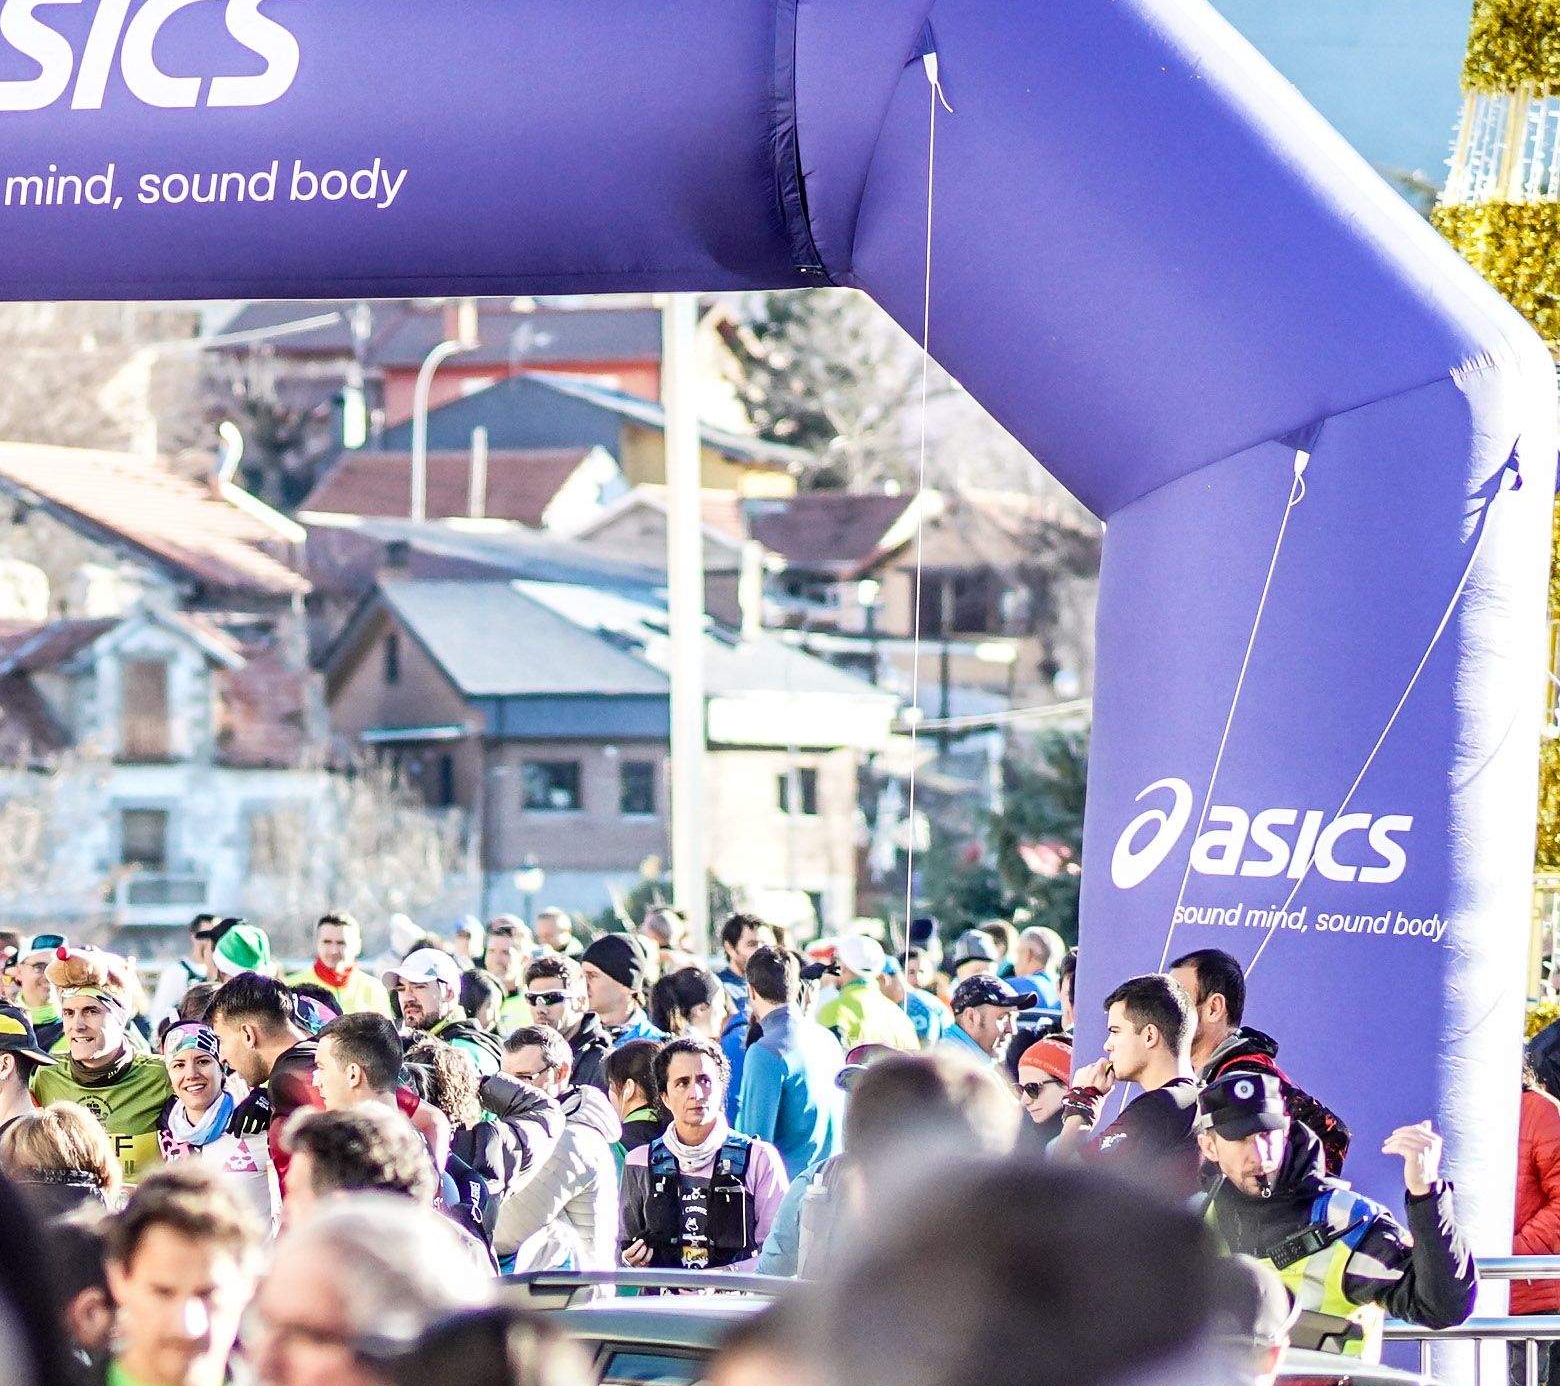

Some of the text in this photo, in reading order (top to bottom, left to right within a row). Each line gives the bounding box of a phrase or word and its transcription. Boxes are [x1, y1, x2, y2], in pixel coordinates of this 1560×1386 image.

[4, 162, 125, 211] mind,
[137, 160, 278, 205] sound
[289, 157, 408, 209] body
[1174, 901, 1448, 942] sound mind, sound body
